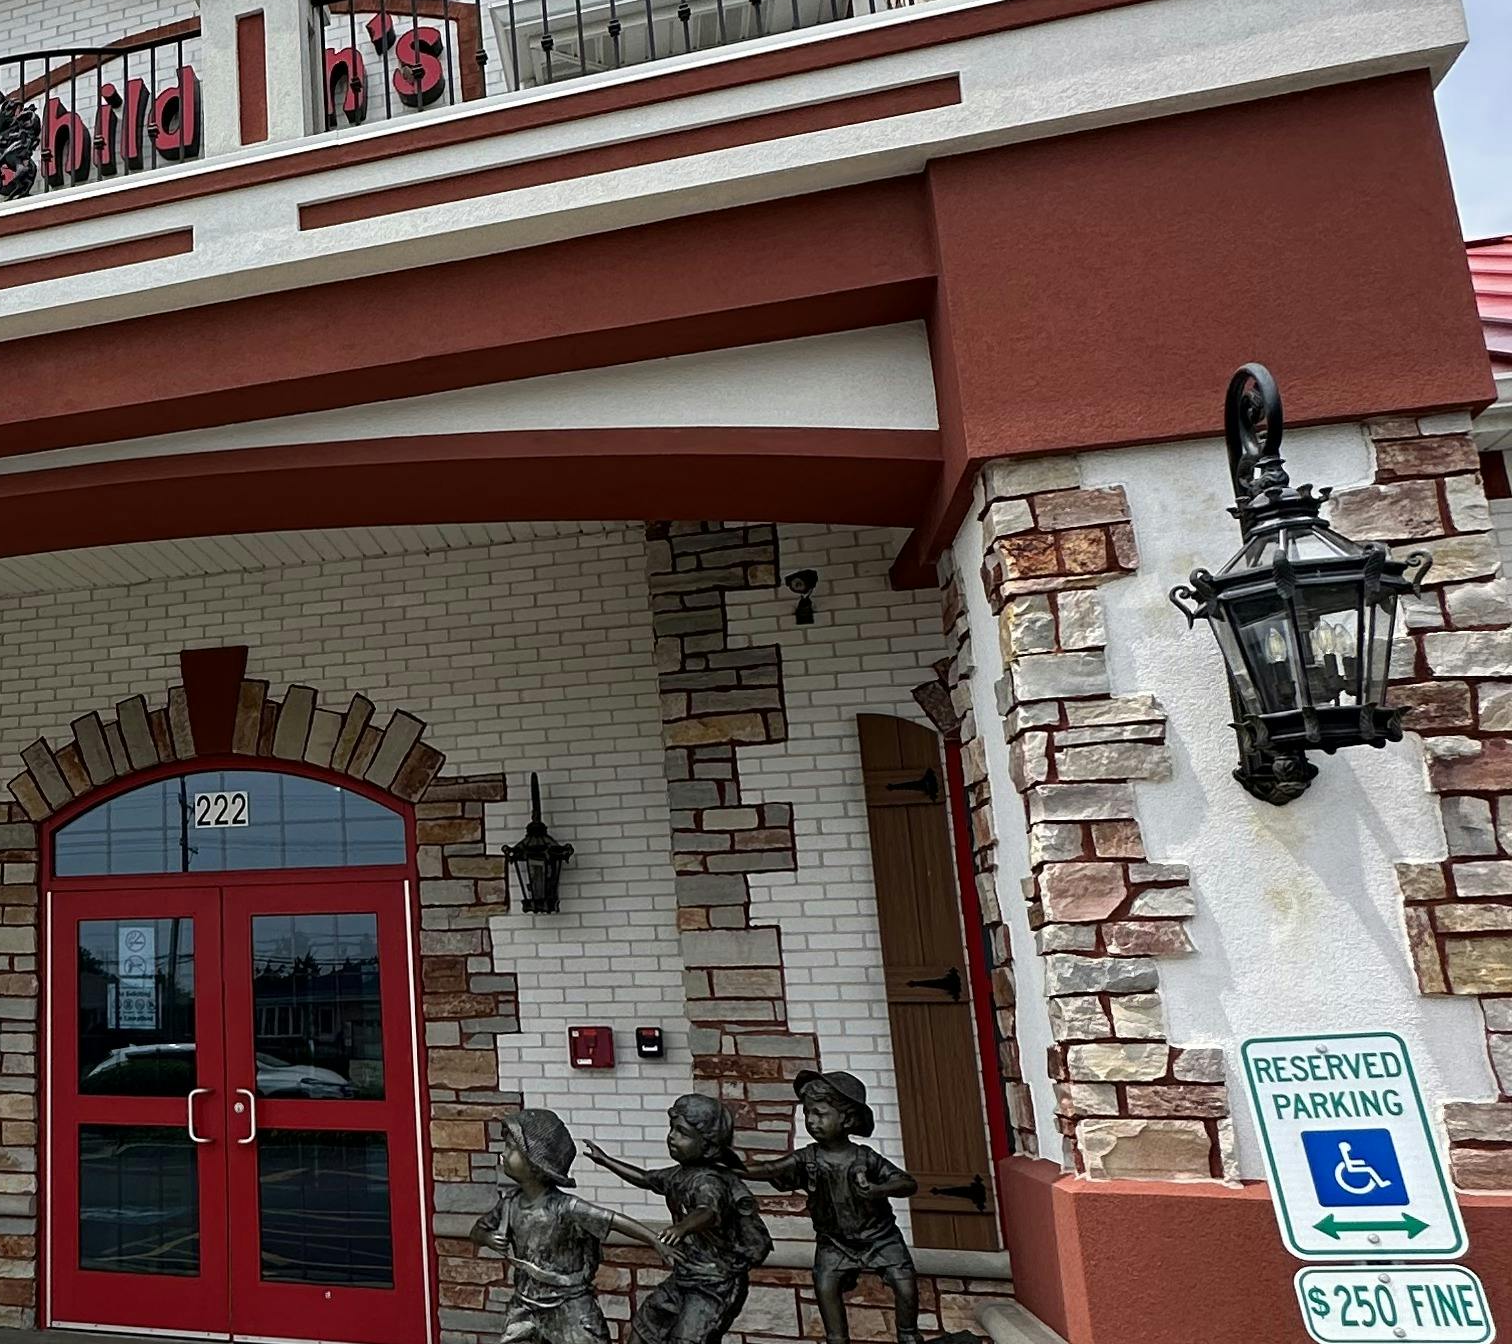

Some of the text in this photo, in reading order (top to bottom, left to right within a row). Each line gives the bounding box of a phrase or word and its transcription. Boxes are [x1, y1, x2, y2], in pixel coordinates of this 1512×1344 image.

[197, 793, 246, 826] 222
[1253, 1052, 1402, 1083] RESERVED
[1272, 1089, 1404, 1120] PARKING
[1308, 1284, 1484, 1328] $250 FINE
